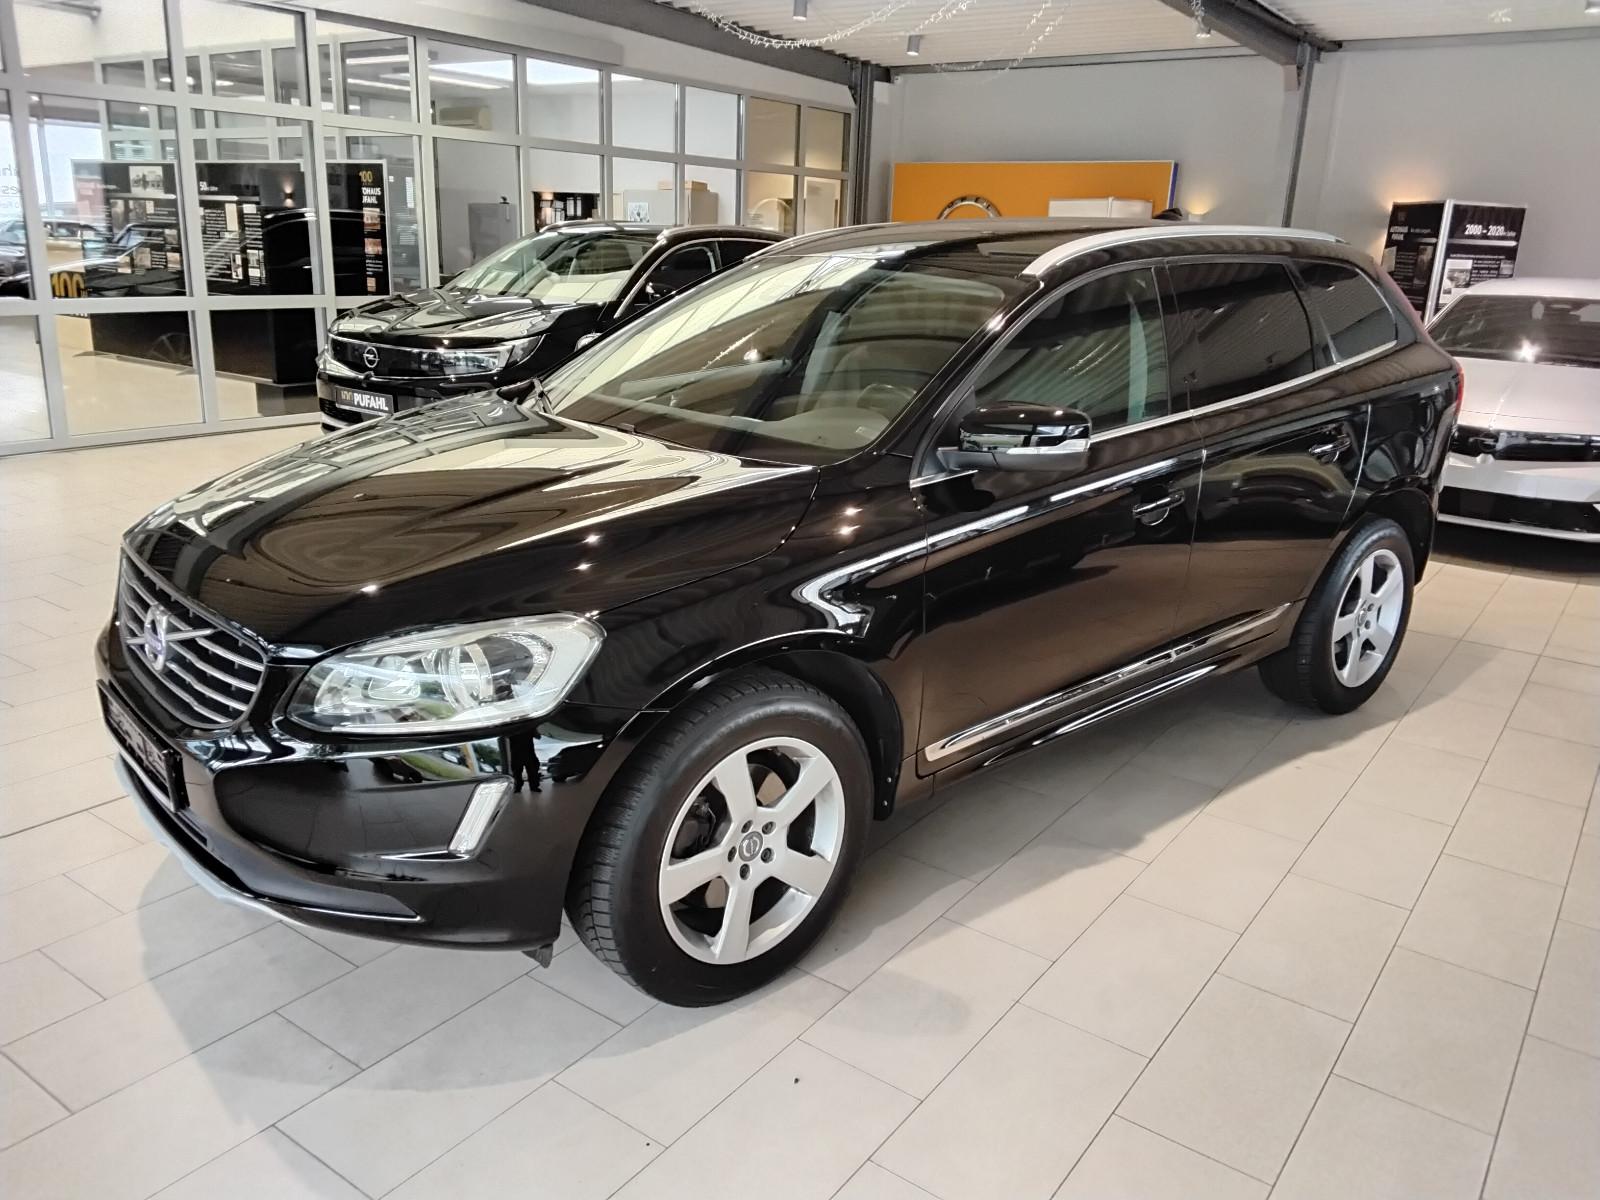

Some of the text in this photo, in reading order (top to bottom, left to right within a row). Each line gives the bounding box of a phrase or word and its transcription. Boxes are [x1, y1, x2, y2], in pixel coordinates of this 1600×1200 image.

[358, 170, 374, 183] 100
[1464, 224, 1482, 235] 2000
[353, 392, 389, 411] PUFAHL
